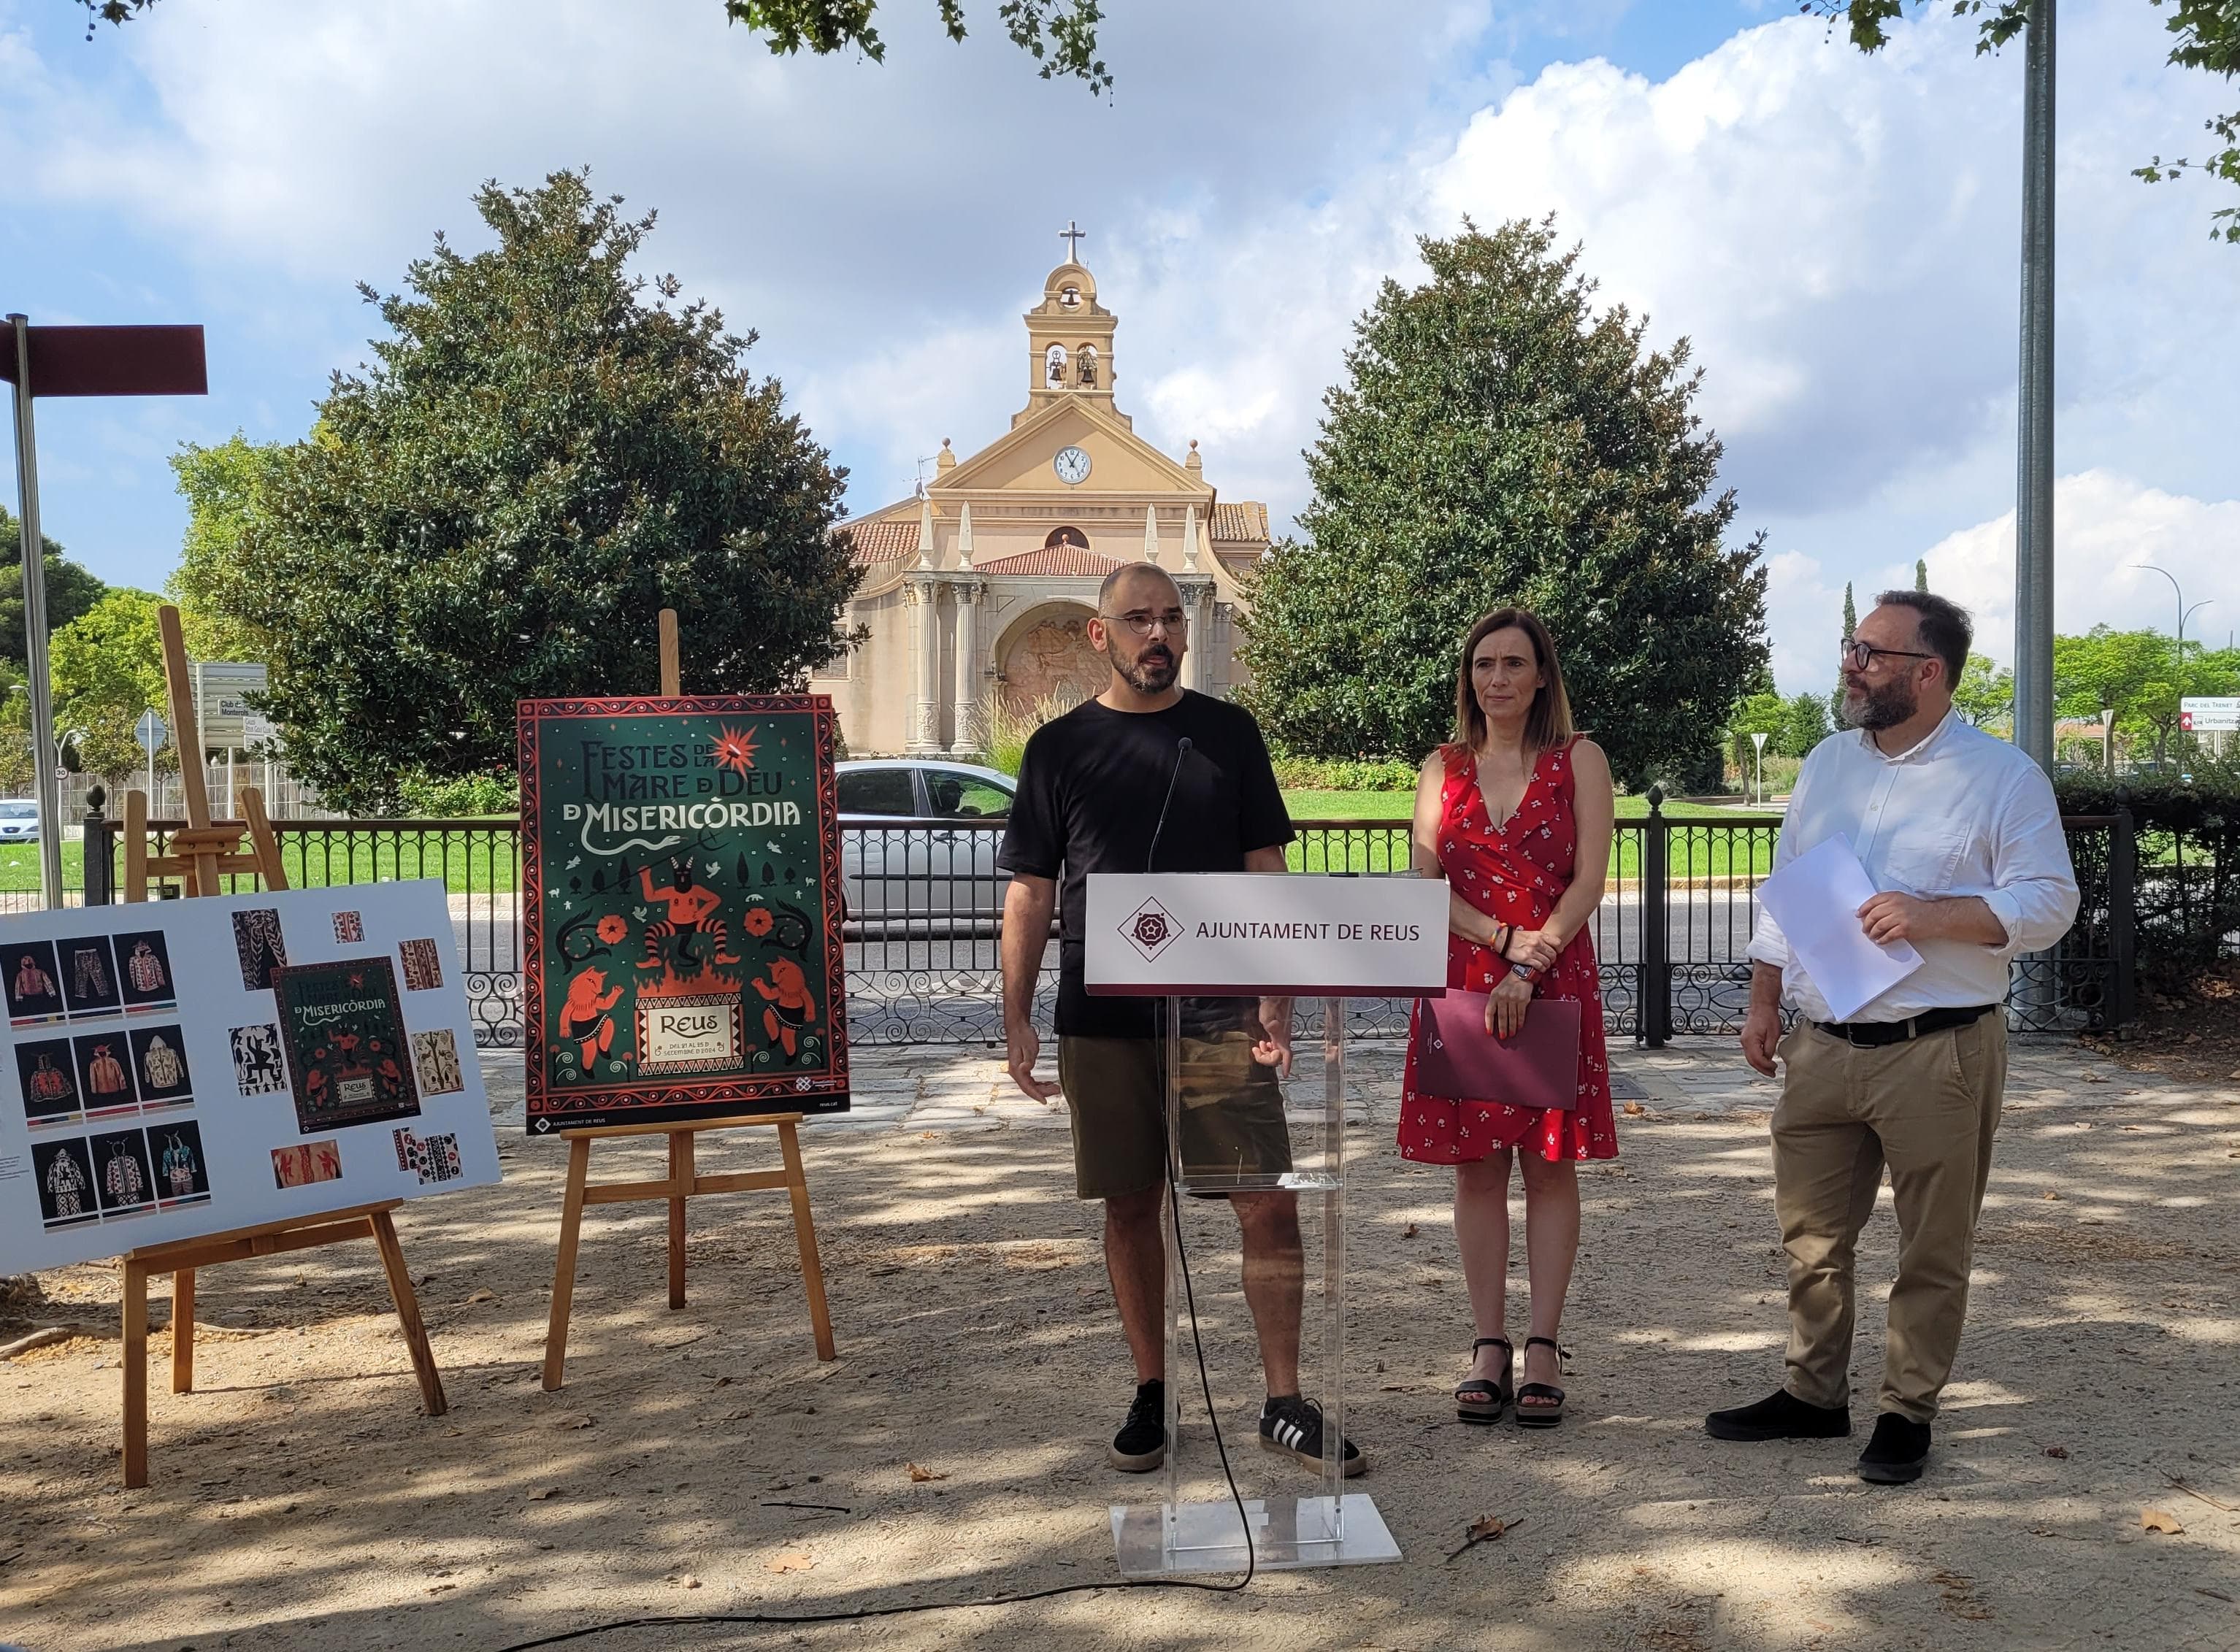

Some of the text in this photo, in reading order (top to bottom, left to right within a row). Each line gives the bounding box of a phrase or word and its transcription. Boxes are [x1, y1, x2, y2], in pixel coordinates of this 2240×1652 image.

[581, 741, 689, 772] FESTES
[601, 772, 690, 800] MARE
[1196, 921, 1420, 941] AJUNTAMENT DE REUS
